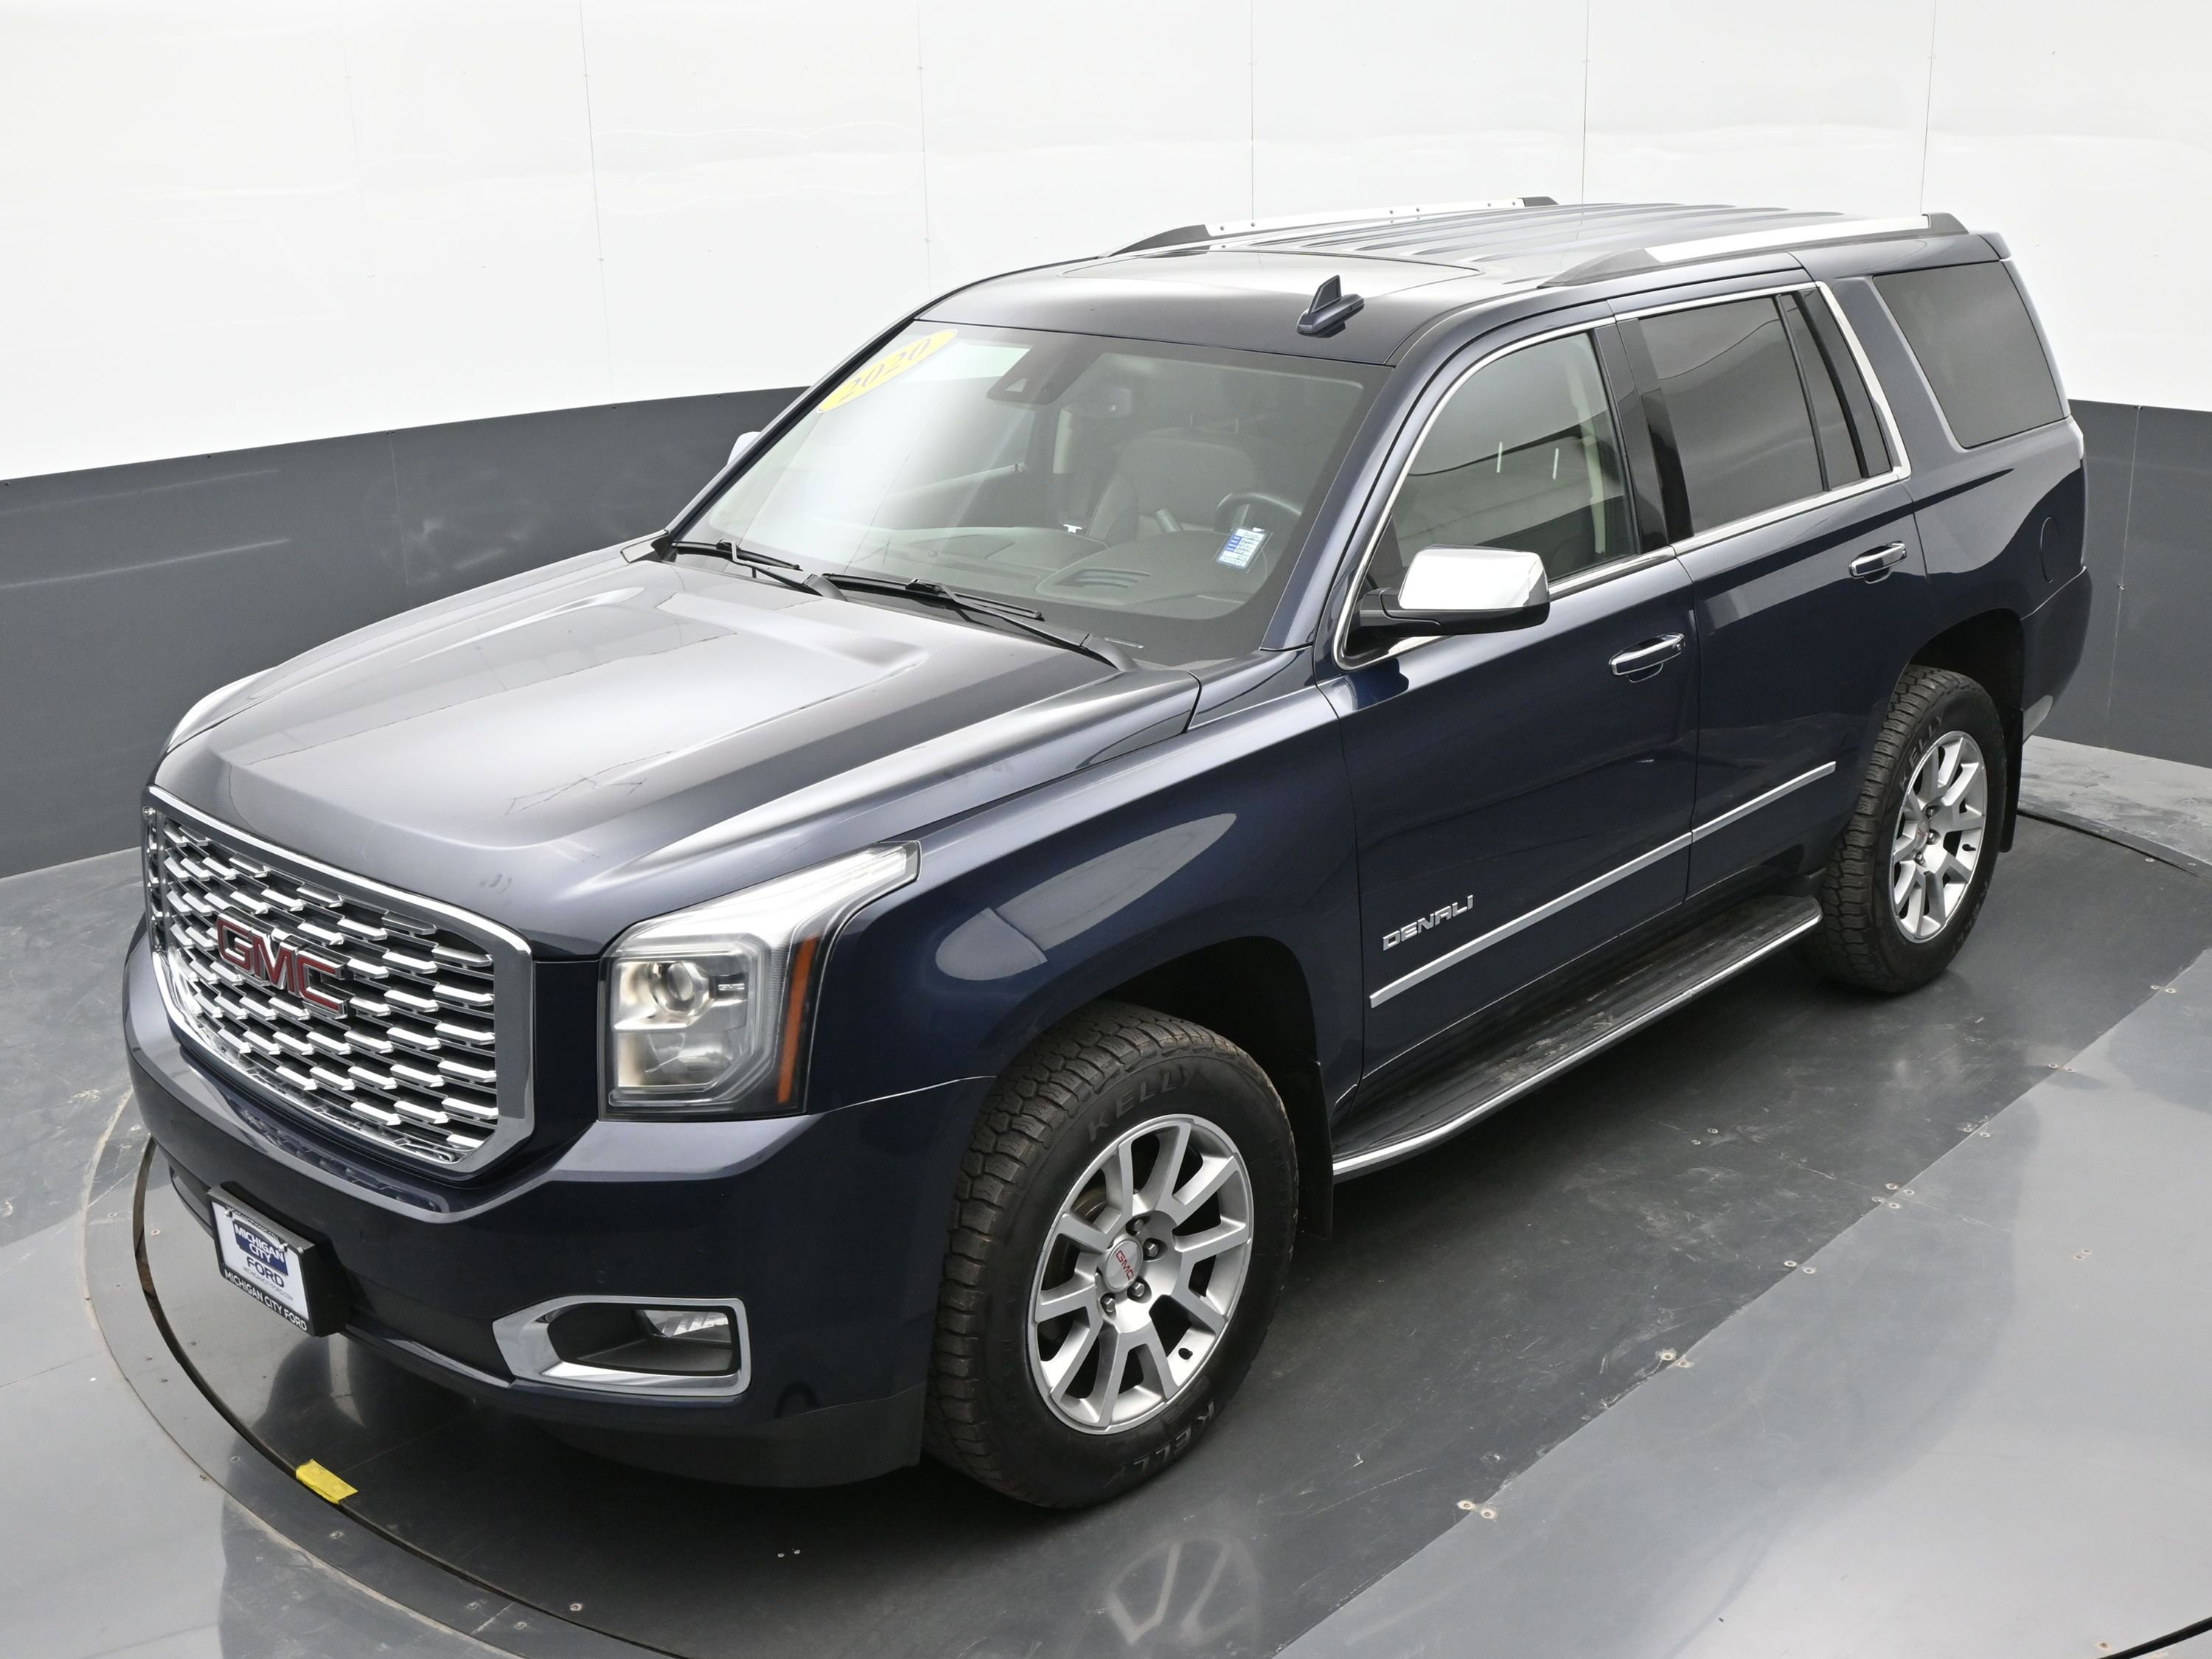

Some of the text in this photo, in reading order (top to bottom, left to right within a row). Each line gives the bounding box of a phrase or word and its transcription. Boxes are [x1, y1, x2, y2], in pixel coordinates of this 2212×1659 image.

[838, 338, 932, 403] 2020
[1382, 894, 1474, 951] DENALI
[217, 913, 348, 1017] GMC
[1087, 1065, 1202, 1143] KELLY
[234, 1223, 285, 1263] MICHIGAN
[249, 1243, 271, 1263] CITY
[1116, 1250, 1134, 1281] GMC
[224, 1268, 307, 1332] MICHIGAN CITY FORD
[246, 1256, 285, 1288] FORD
